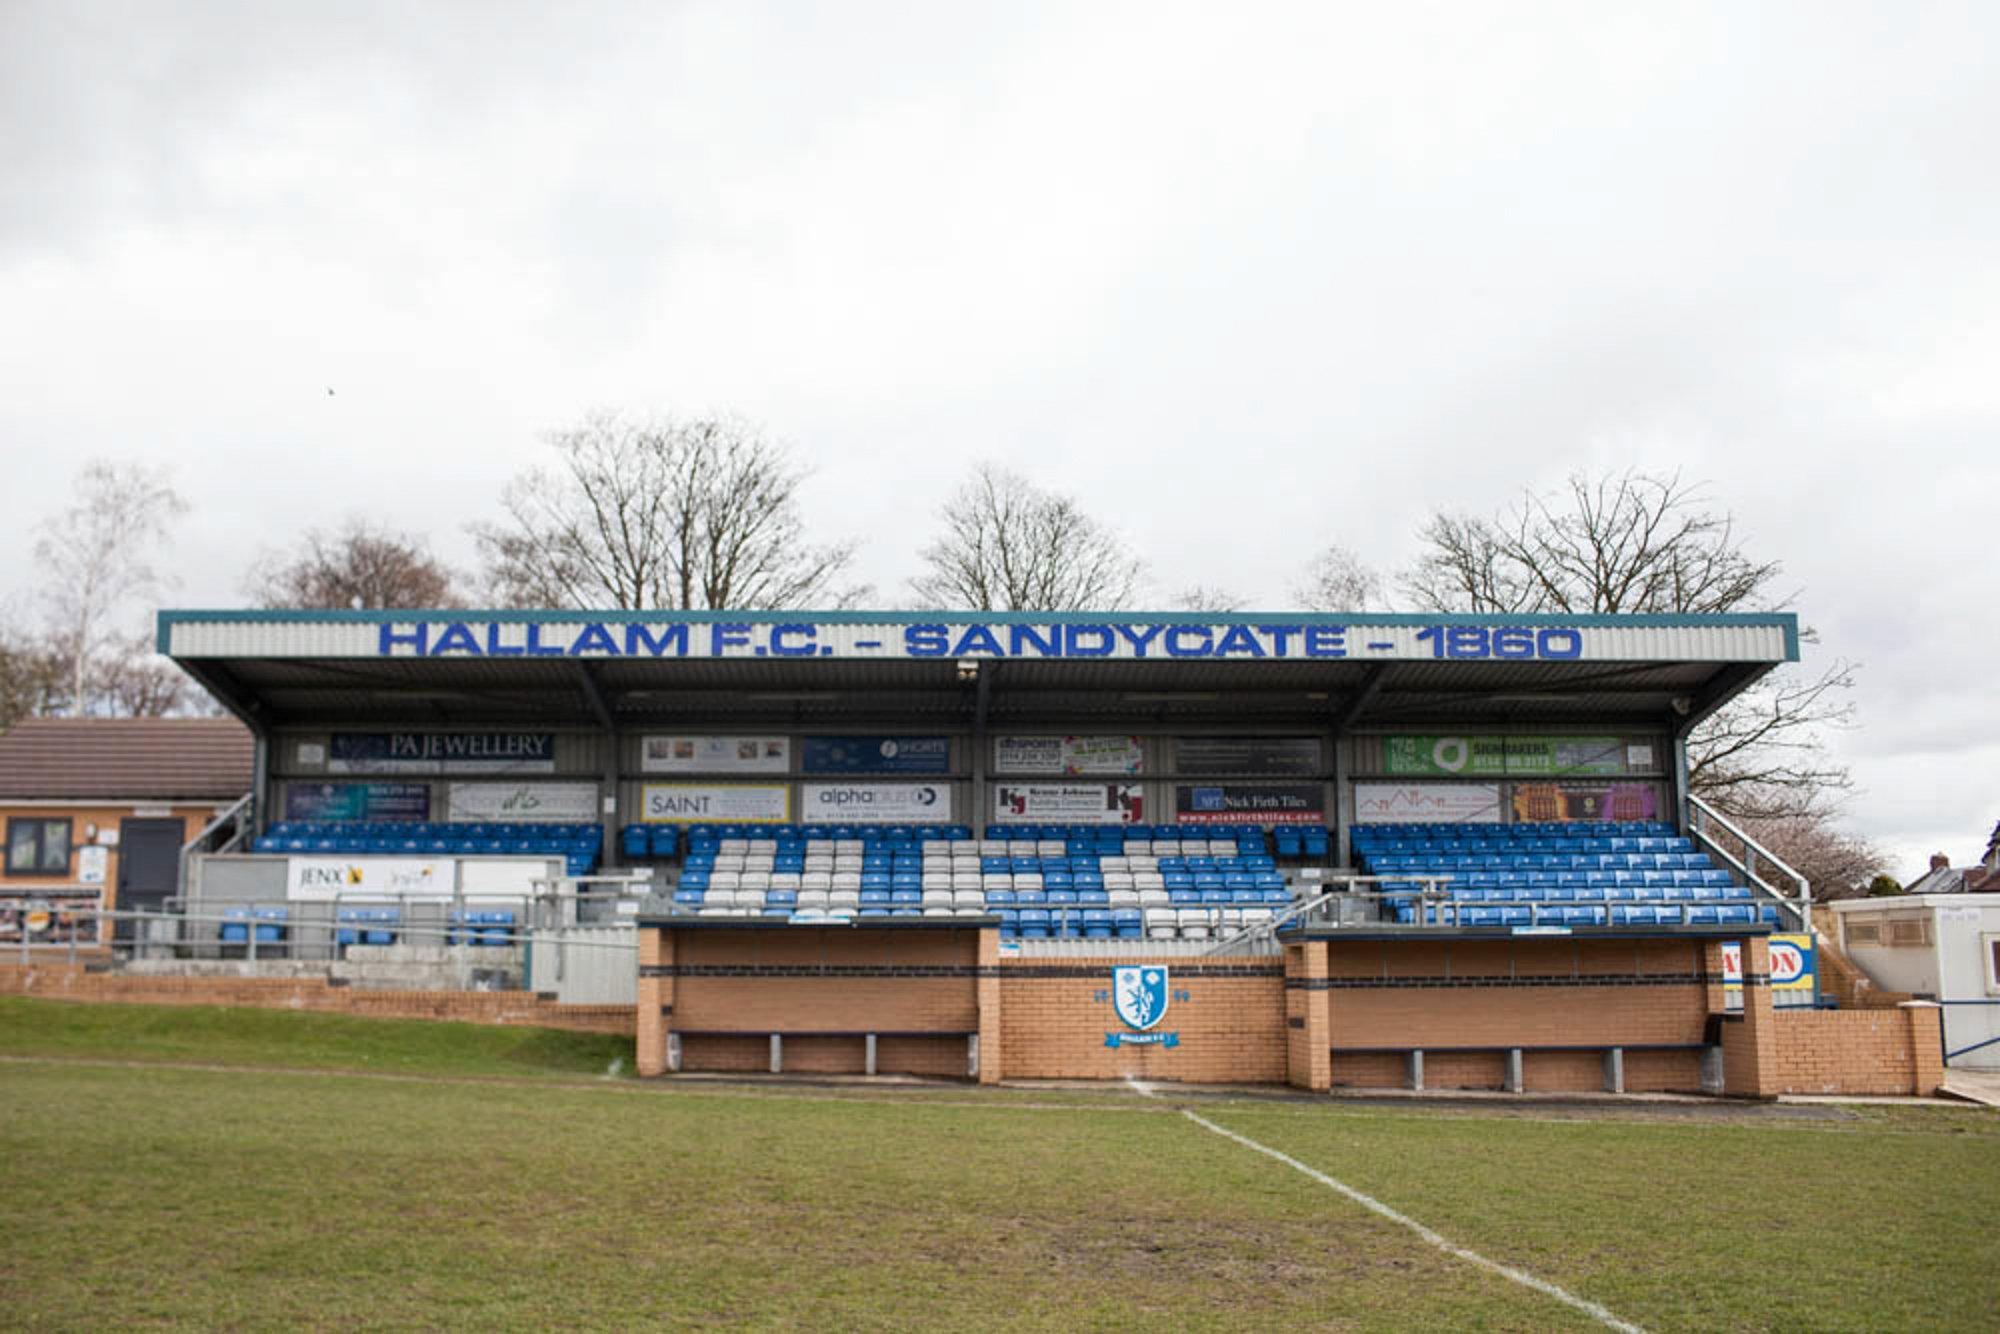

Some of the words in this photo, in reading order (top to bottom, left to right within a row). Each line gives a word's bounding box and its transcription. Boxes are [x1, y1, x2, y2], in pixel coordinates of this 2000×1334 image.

[383, 622, 688, 657] HALLAM
[711, 623, 833, 657] F.C.
[904, 623, 1346, 658] SANDYGATE
[1417, 625, 1582, 658] 1860
[390, 735, 418, 755] PA
[420, 735, 545, 758] JEWELLERY
[651, 795, 711, 814] SAINT
[1224, 795, 1249, 807] Nick
[1252, 795, 1279, 807] Firth
[1281, 795, 1307, 807] Tiles
[299, 867, 342, 887] JENX
